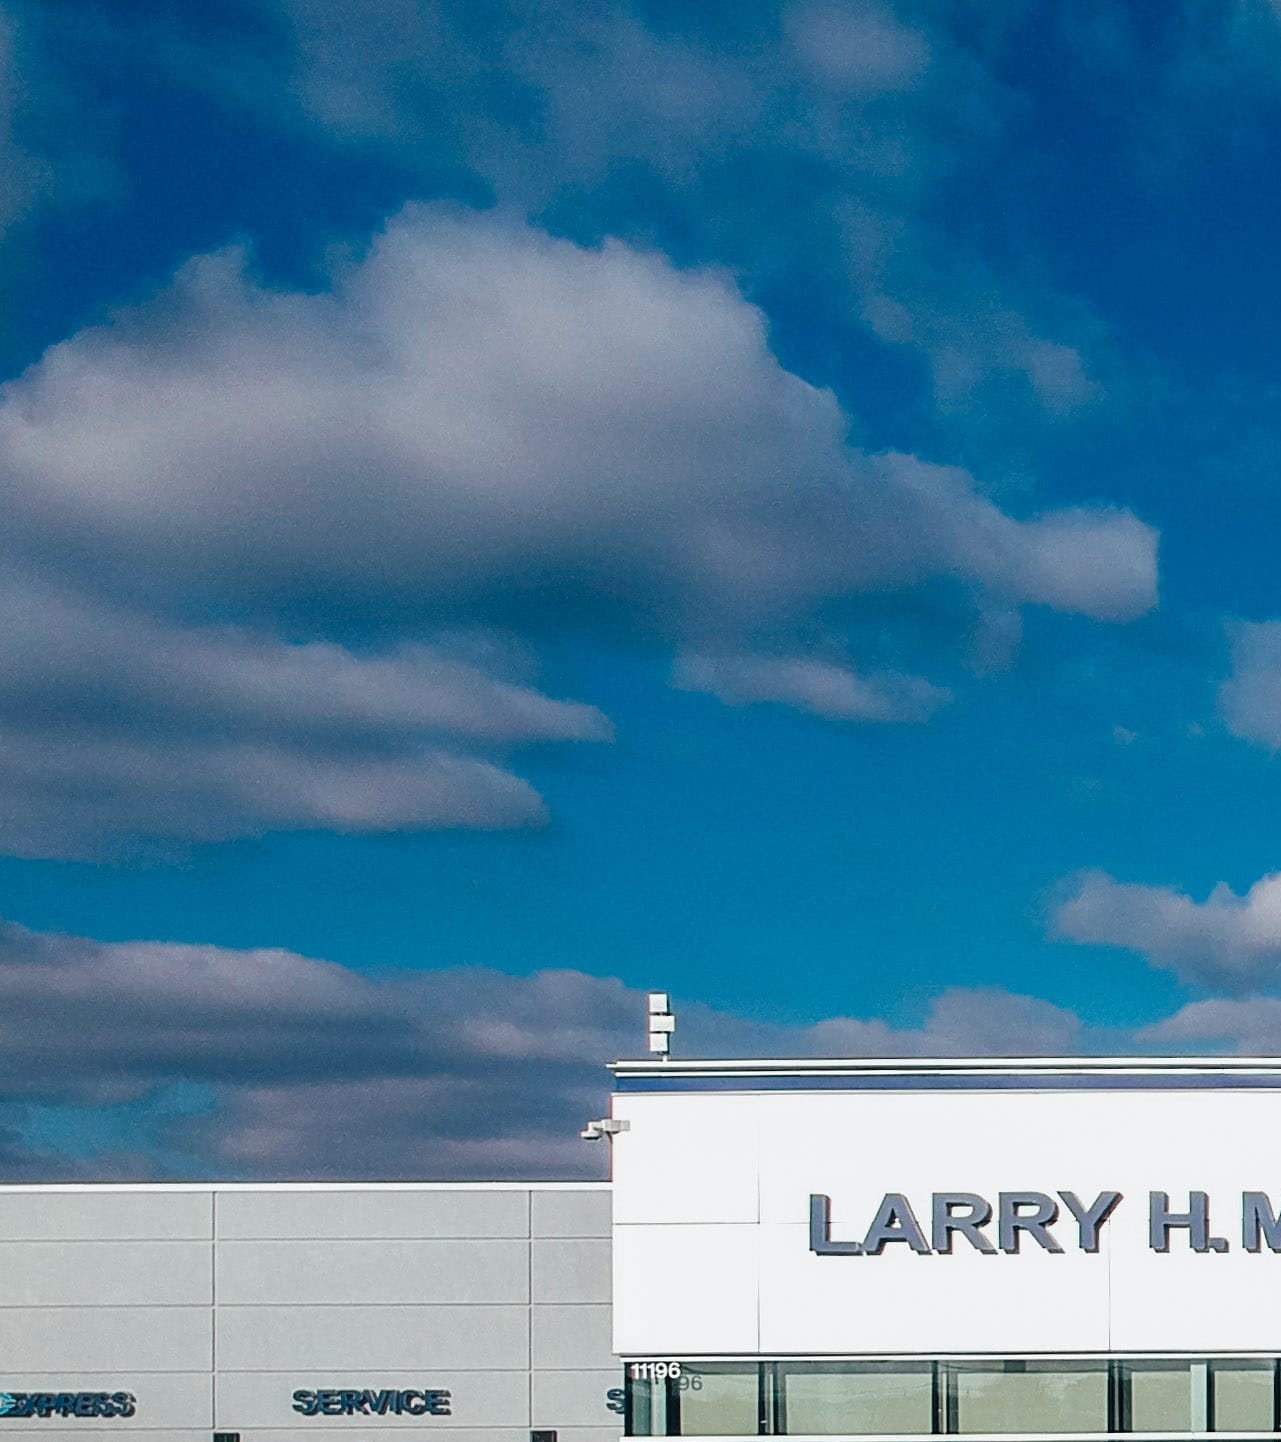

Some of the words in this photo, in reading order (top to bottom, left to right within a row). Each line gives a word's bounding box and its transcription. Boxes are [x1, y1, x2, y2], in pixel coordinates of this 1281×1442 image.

[808, 1189, 1125, 1256] LARRY
[1148, 1189, 1230, 1254] H.
[630, 1362, 682, 1380] 11196
[292, 1389, 452, 1416] SERVICE
